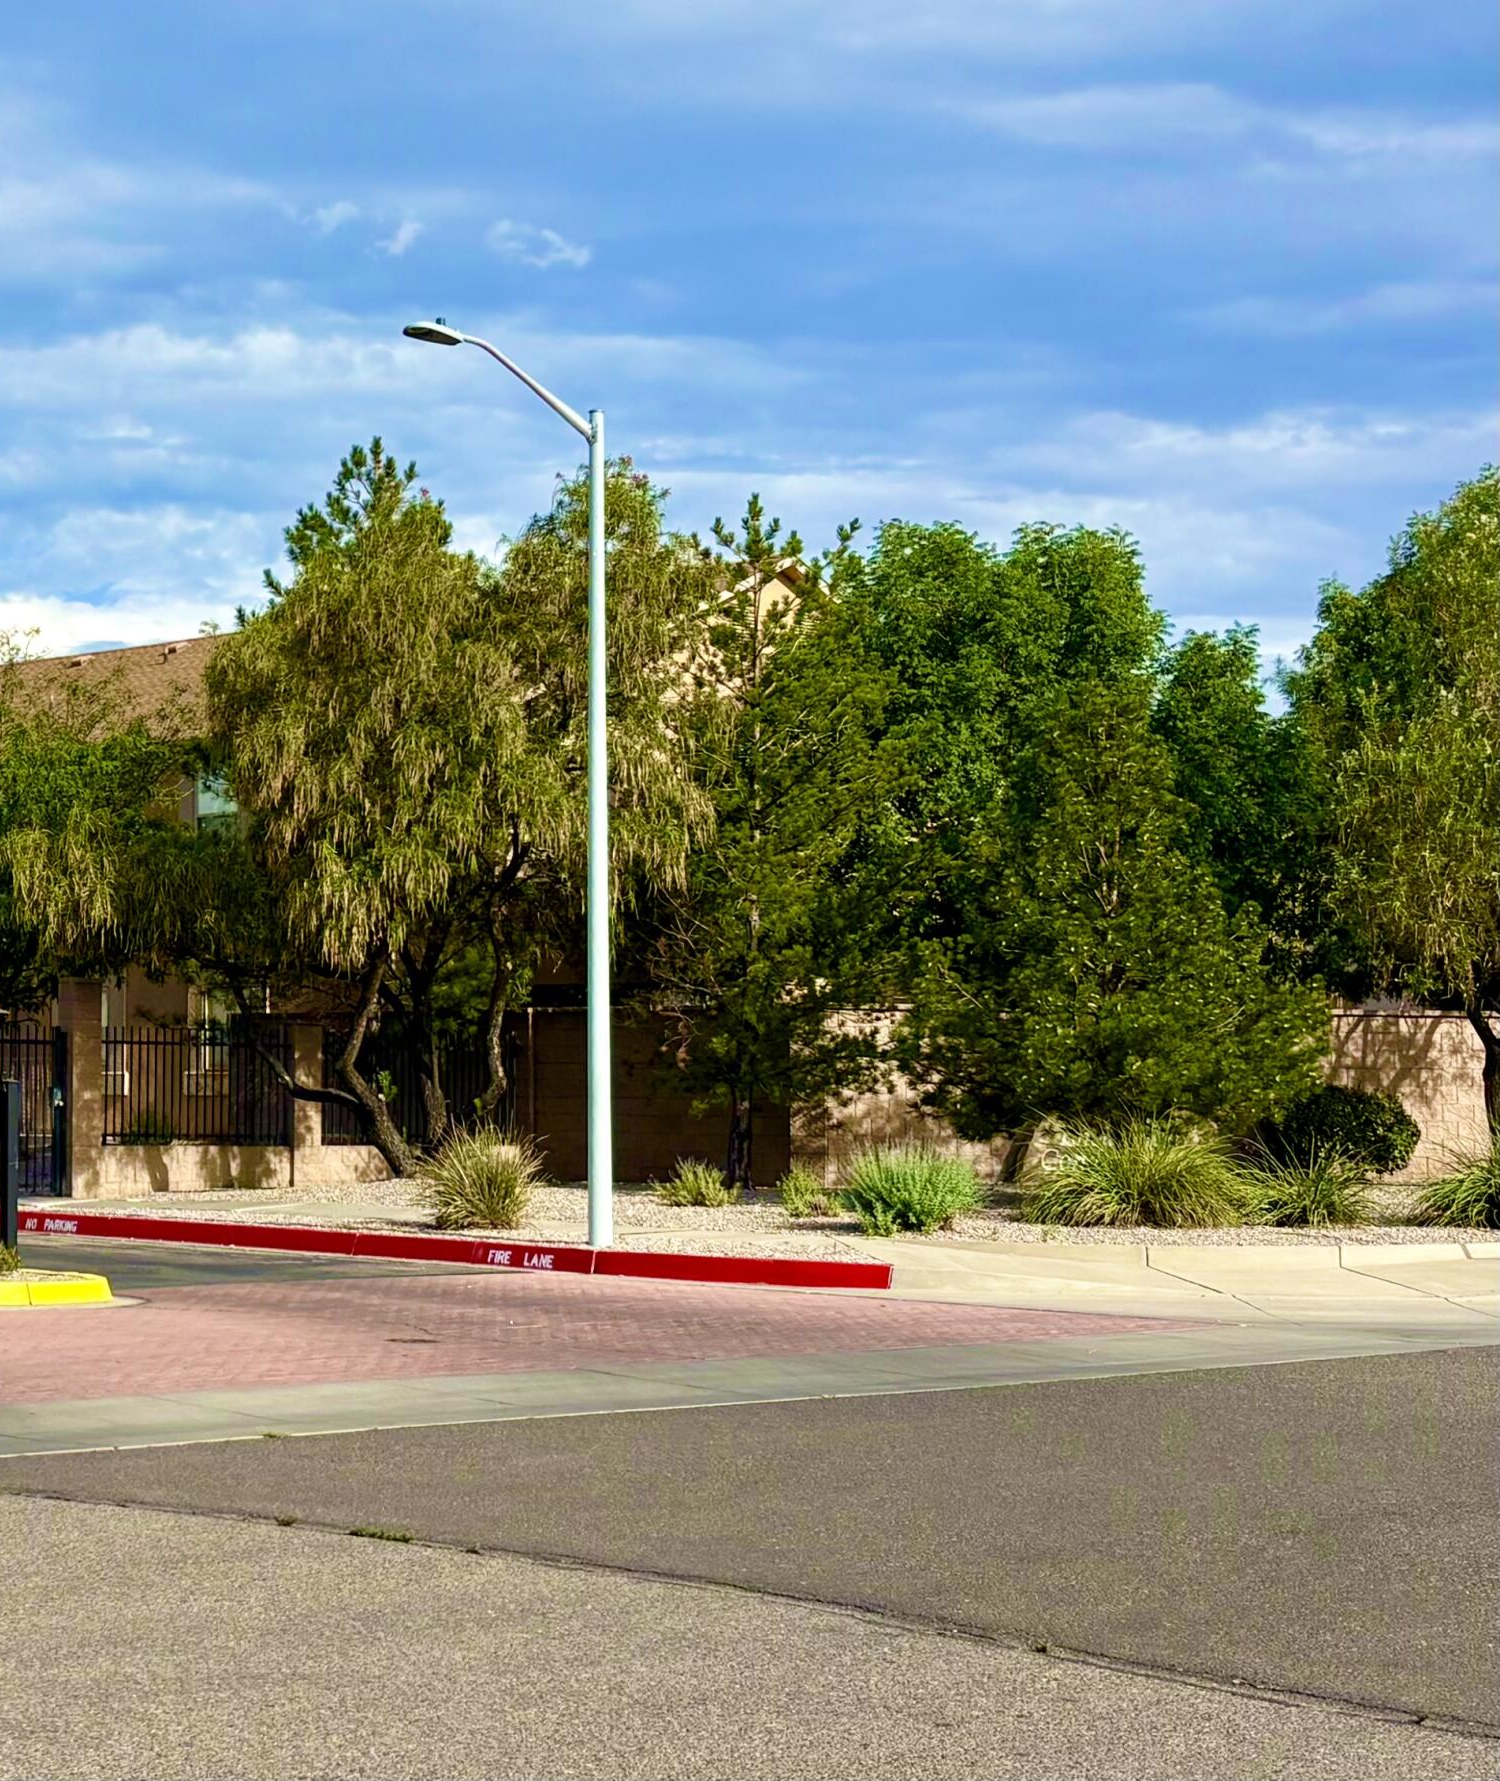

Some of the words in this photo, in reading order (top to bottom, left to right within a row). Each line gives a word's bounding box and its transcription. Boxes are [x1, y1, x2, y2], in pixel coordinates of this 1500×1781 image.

[25, 1218, 38, 1230] NO
[43, 1218, 78, 1233] PARKING
[487, 1249, 512, 1265] FIRE
[523, 1252, 555, 1269] LANE
